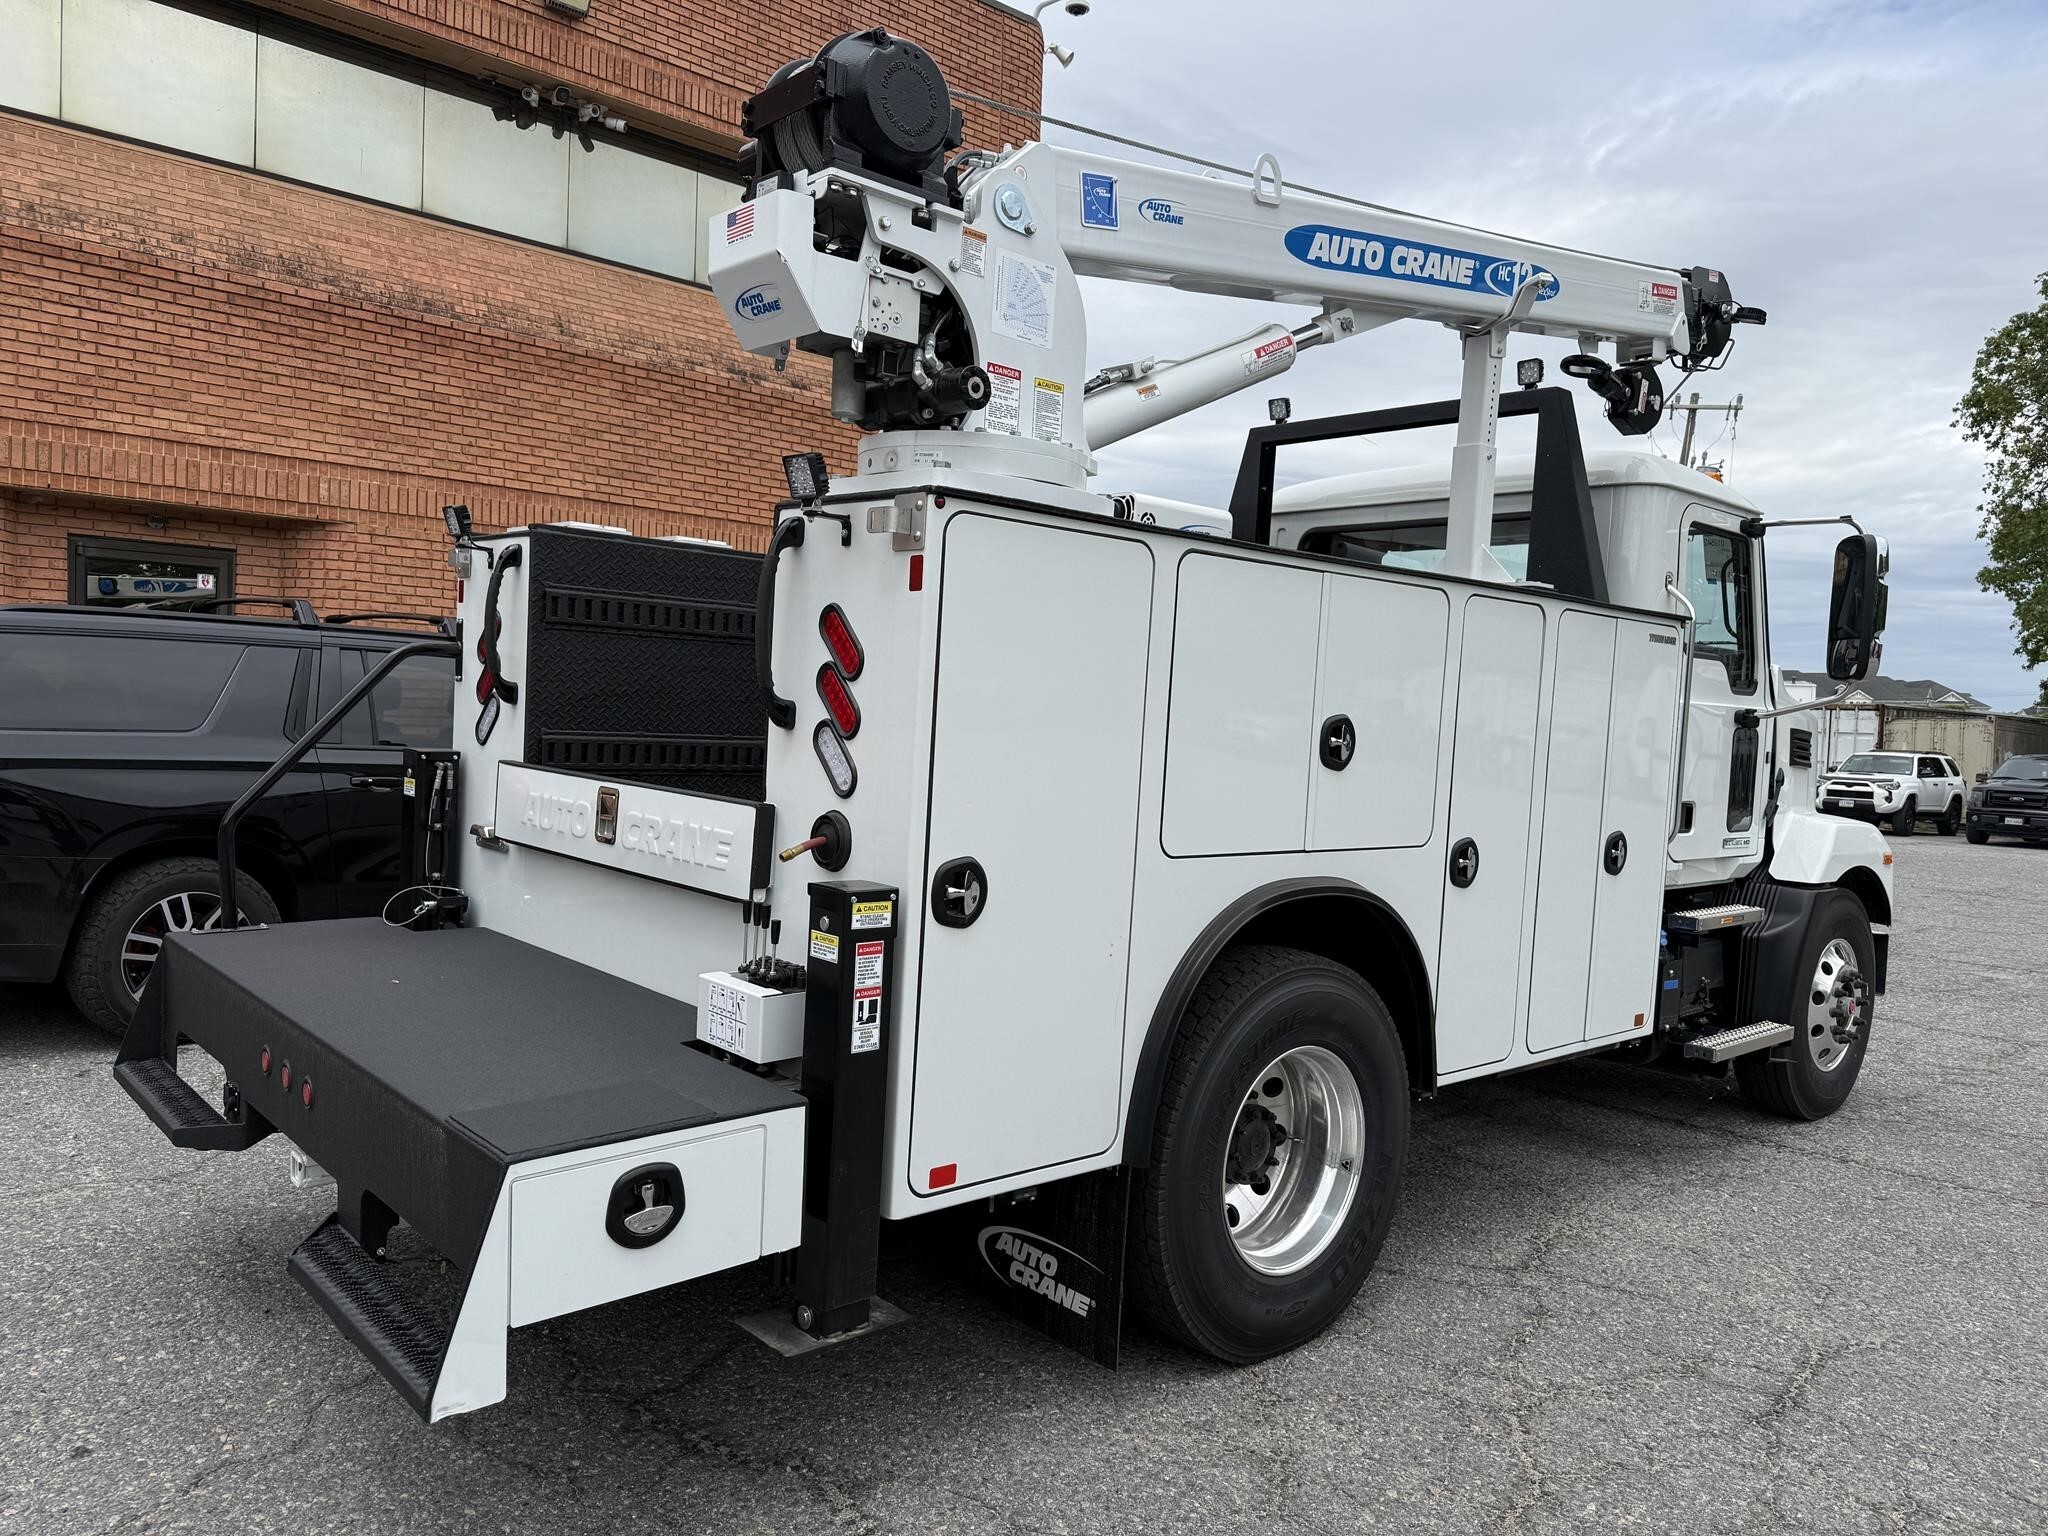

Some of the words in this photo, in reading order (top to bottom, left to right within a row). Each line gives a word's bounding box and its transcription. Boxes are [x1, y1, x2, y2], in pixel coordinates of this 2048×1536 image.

[1146, 201, 1172, 213] AUTO
[1152, 212, 1184, 225] CRANE
[1306, 231, 1385, 271] AUTO
[1390, 244, 1475, 285] CRANE
[1658, 287, 1676, 297] DANGER
[741, 292, 765, 308] AUTO
[751, 299, 781, 317] CRANE
[1265, 338, 1290, 353] DANGER
[994, 366, 1020, 378] DANGER
[1041, 381, 1063, 391] CAUTION
[521, 791, 592, 839] AUTO
[621, 810, 735, 872] CRANE
[863, 904, 889, 912] CAUTION
[819, 935, 835, 944] CAUTION
[861, 989, 880, 997] DANGER
[995, 1232, 1059, 1277] AUTO
[1009, 1260, 1092, 1318] CRANE
